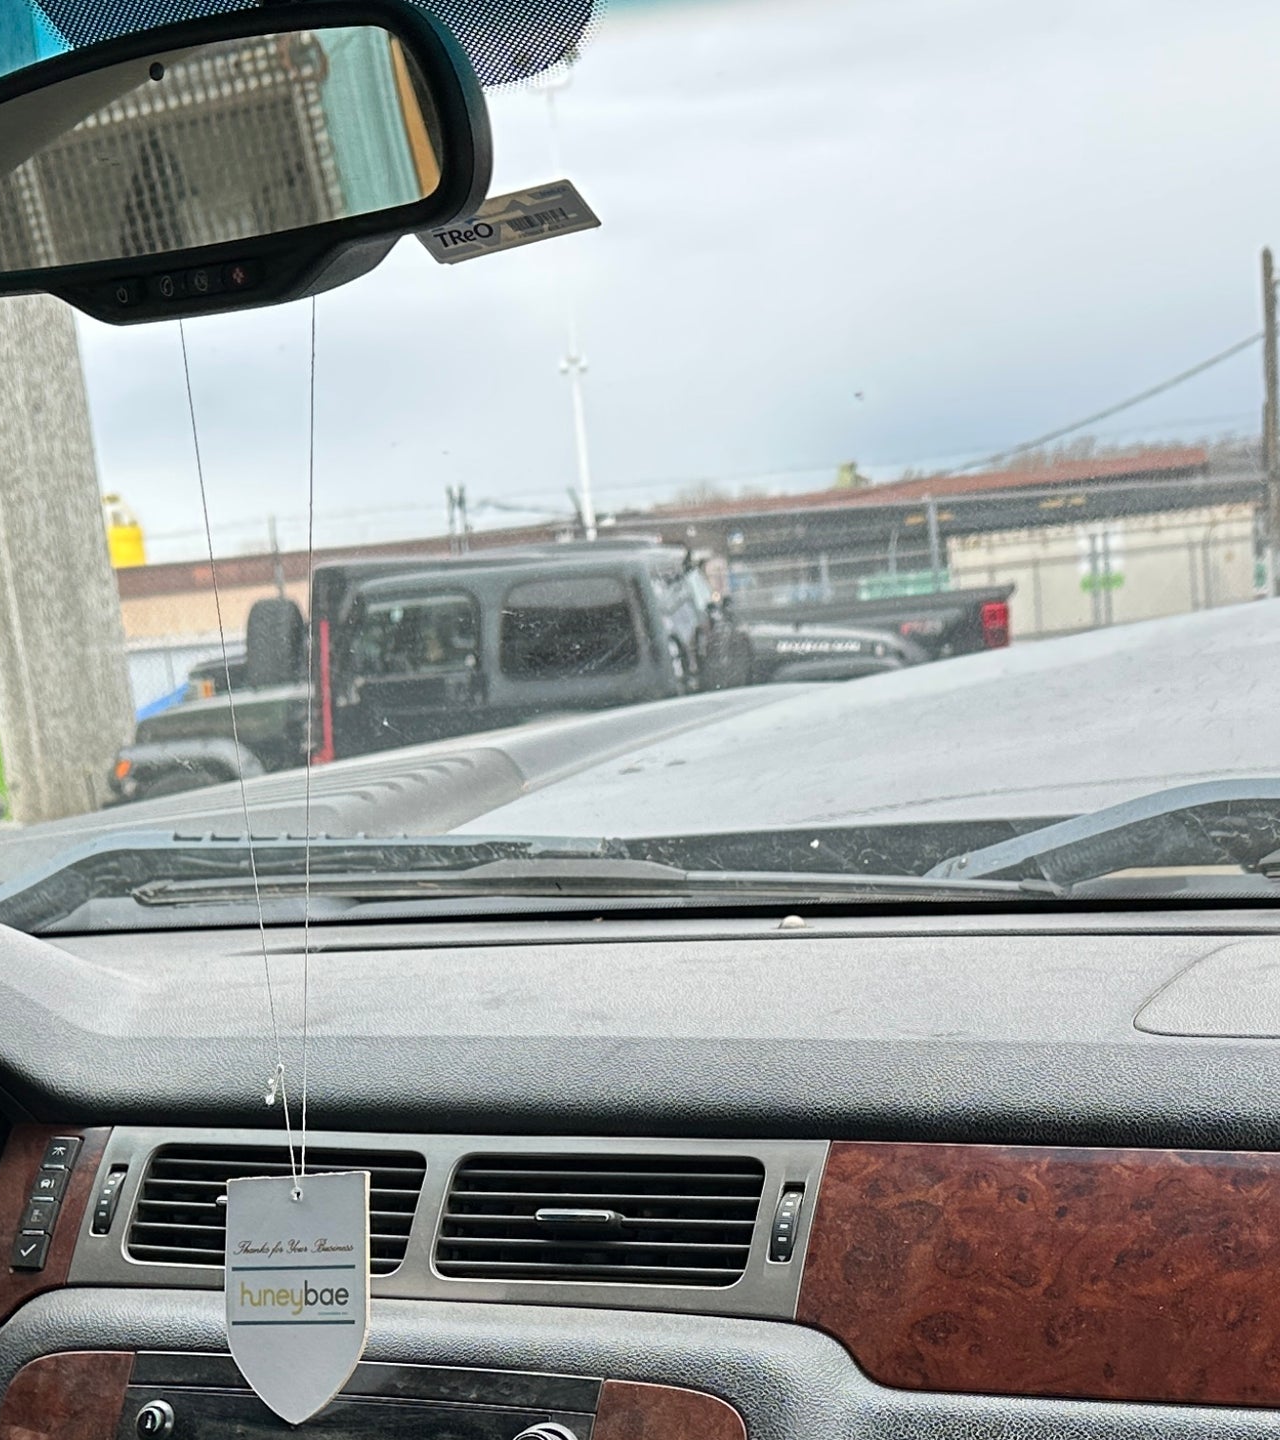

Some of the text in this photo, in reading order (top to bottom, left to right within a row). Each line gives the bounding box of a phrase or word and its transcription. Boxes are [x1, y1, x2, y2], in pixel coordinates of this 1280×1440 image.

[433, 222, 494, 249] TReO
[233, 1238, 355, 1258] Thanks for Your Business
